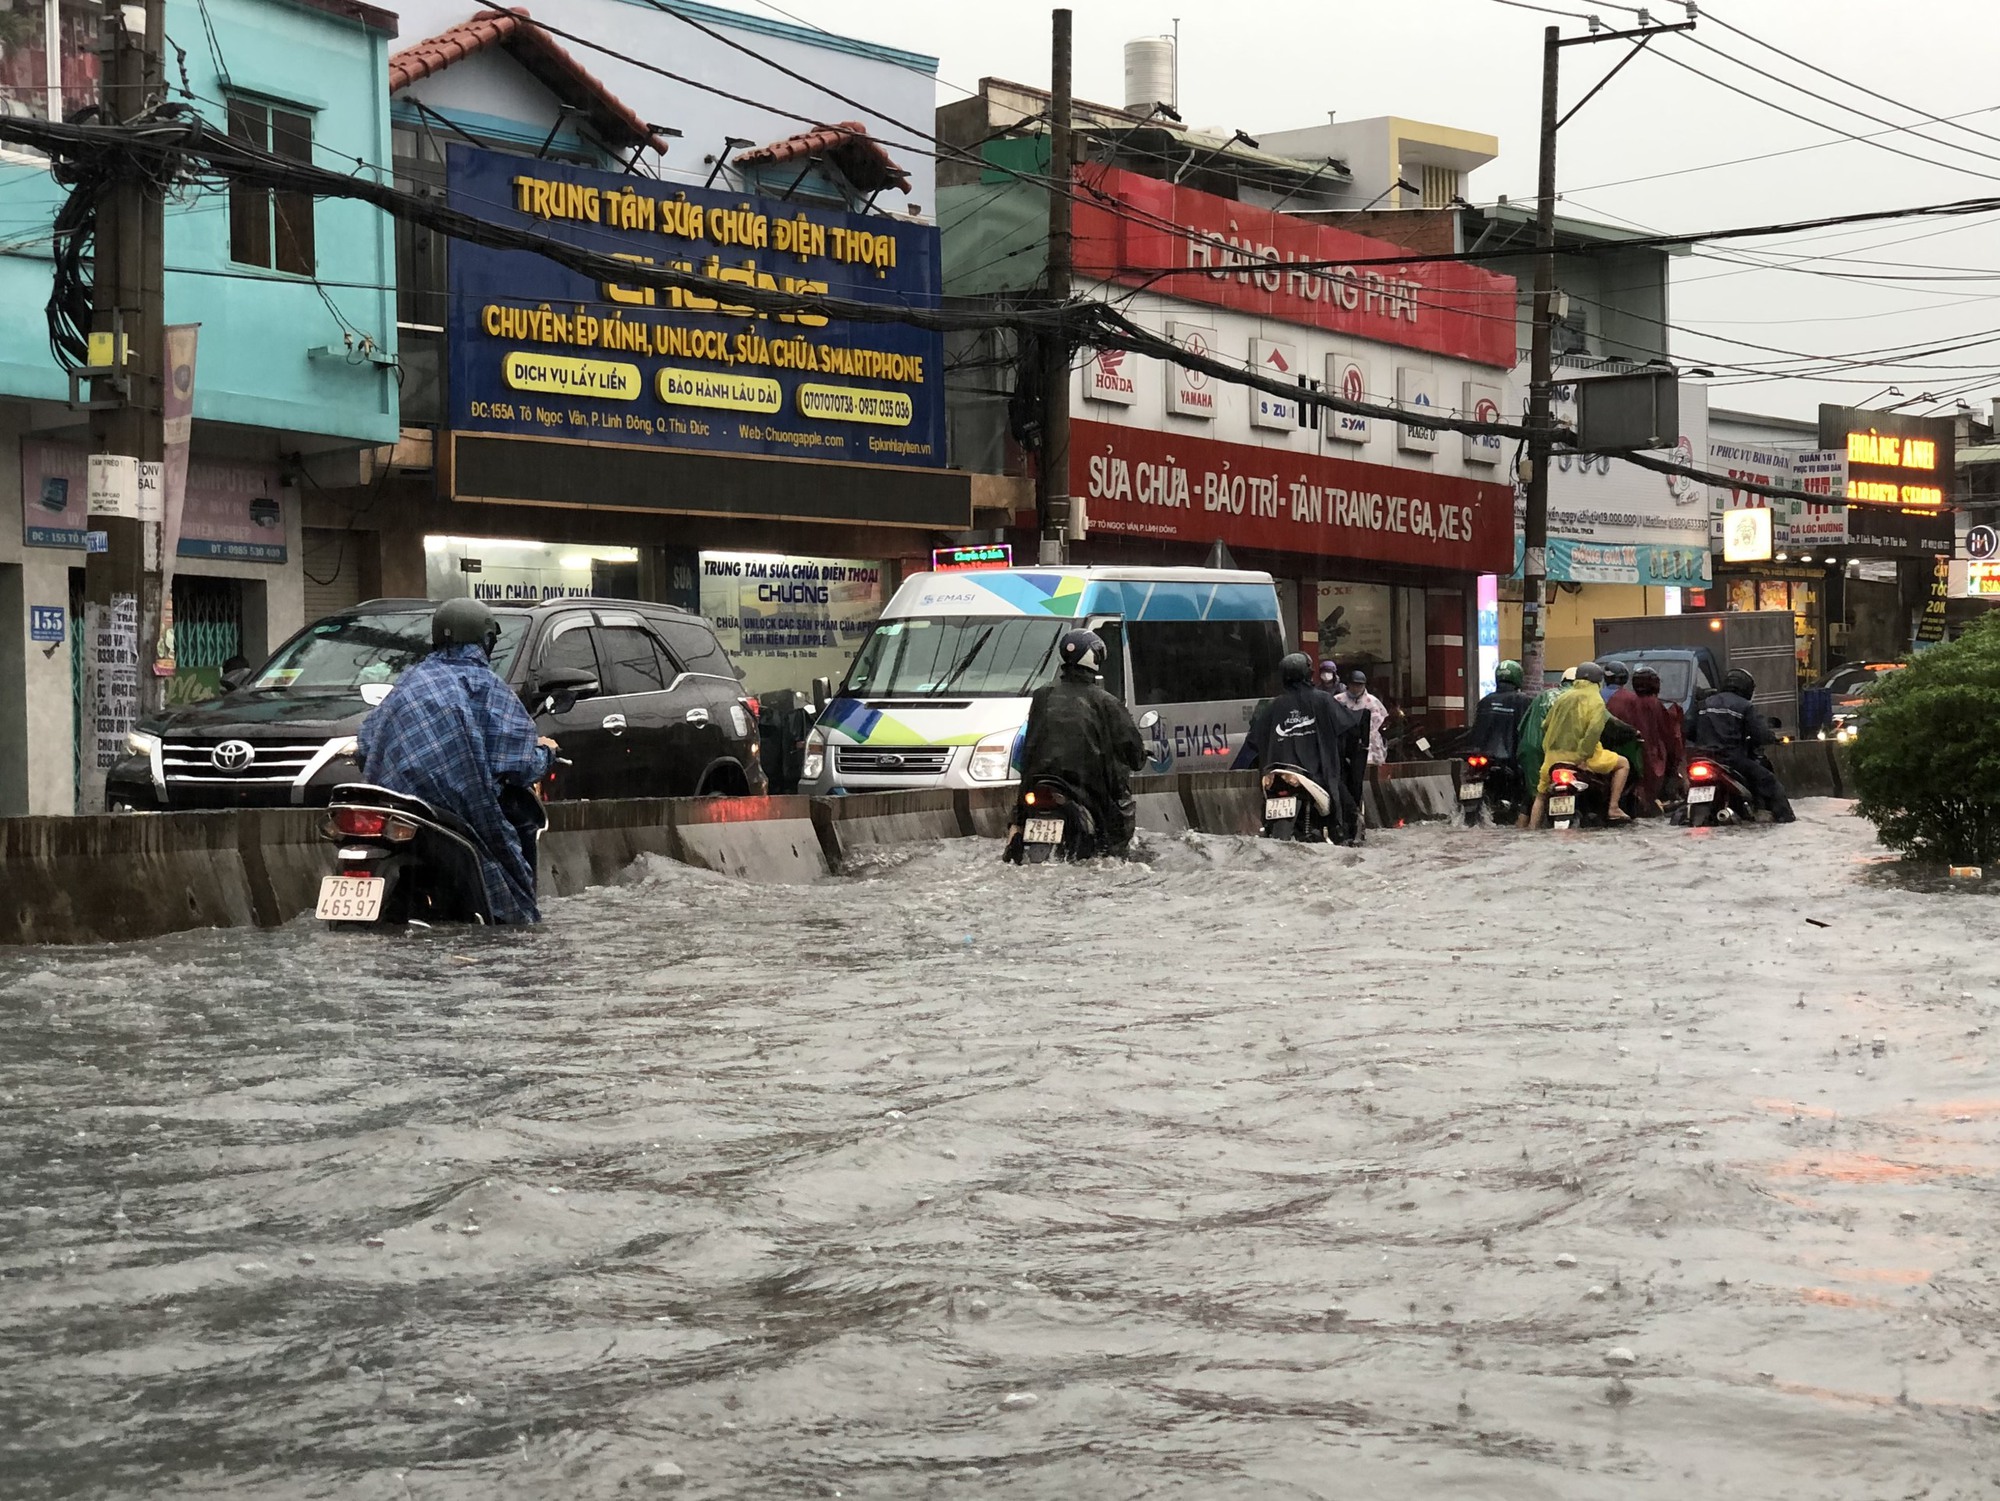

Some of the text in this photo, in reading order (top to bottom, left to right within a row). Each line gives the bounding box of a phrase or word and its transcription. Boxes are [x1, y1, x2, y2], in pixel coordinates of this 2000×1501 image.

[513, 175, 600, 222] TRUNG
[602, 185, 654, 231] TÂM
[771, 212, 825, 263] ĐIỆN
[828, 226, 896, 279] THOẠI
[1187, 219, 1280, 292] HOÀNG
[1364, 266, 1422, 323] PHÁT
[482, 303, 924, 384] CHUYÊN: ÉP KÍNH, UNLOCK, SỬA CHỮA SMARTPHONE
[515, 363, 546, 385] DỊCH
[550, 368, 568, 388] VỤ
[571, 363, 596, 387] LẤY
[1096, 374, 1134, 393] HONDA
[668, 375, 777, 405] BẢO HÀNH LÂU DÀI
[1180, 390, 1213, 408] YAMAHA
[804, 391, 910, 419] 0707070738 0937 035 036
[536, 406, 563, 427] Ngọc
[568, 409, 589, 428] Vân,
[626, 413, 654, 435] Đông,
[690, 419, 710, 437] Đức
[1341, 417, 1365, 431] SYM
[1716, 445, 1741, 462] PHỤC
[1741, 447, 1752, 464] VỤ
[1799, 454, 1820, 463] QUÁN
[1902, 438, 1935, 469] ANH
[1088, 444, 1132, 502] SỬA
[1136, 455, 1190, 509] CHỮA
[1204, 460, 1246, 515] BẢO
[1289, 474, 1322, 523] TÂN
[1325, 487, 1383, 530] TRANG
[1385, 495, 1408, 533] XE
[1409, 498, 1436, 543] GA,
[1438, 503, 1459, 540] XE
[52, 531, 67, 540] 155
[704, 560, 741, 577] TRUNG
[745, 559, 767, 578] TÂM
[822, 562, 846, 584] ĐIỆN
[474, 579, 502, 599] KÍNH
[505, 581, 537, 599] CHÀO
[758, 582, 828, 604] CHƯƠNG
[937, 594, 975, 602] EMASI
[1926, 600, 1946, 613] 20K
[34, 610, 62, 630] 155
[744, 616, 776, 630] UNLOCK
[98, 633, 112, 647] CHO
[745, 633, 763, 645] LINH
[787, 634, 800, 646] ZIN
[802, 634, 827, 646] APPLE
[1174, 722, 1228, 757] EMASI
[880, 755, 897, 764] Ford
[330, 880, 372, 898] 76-G1
[321, 899, 376, 917] 465.97
